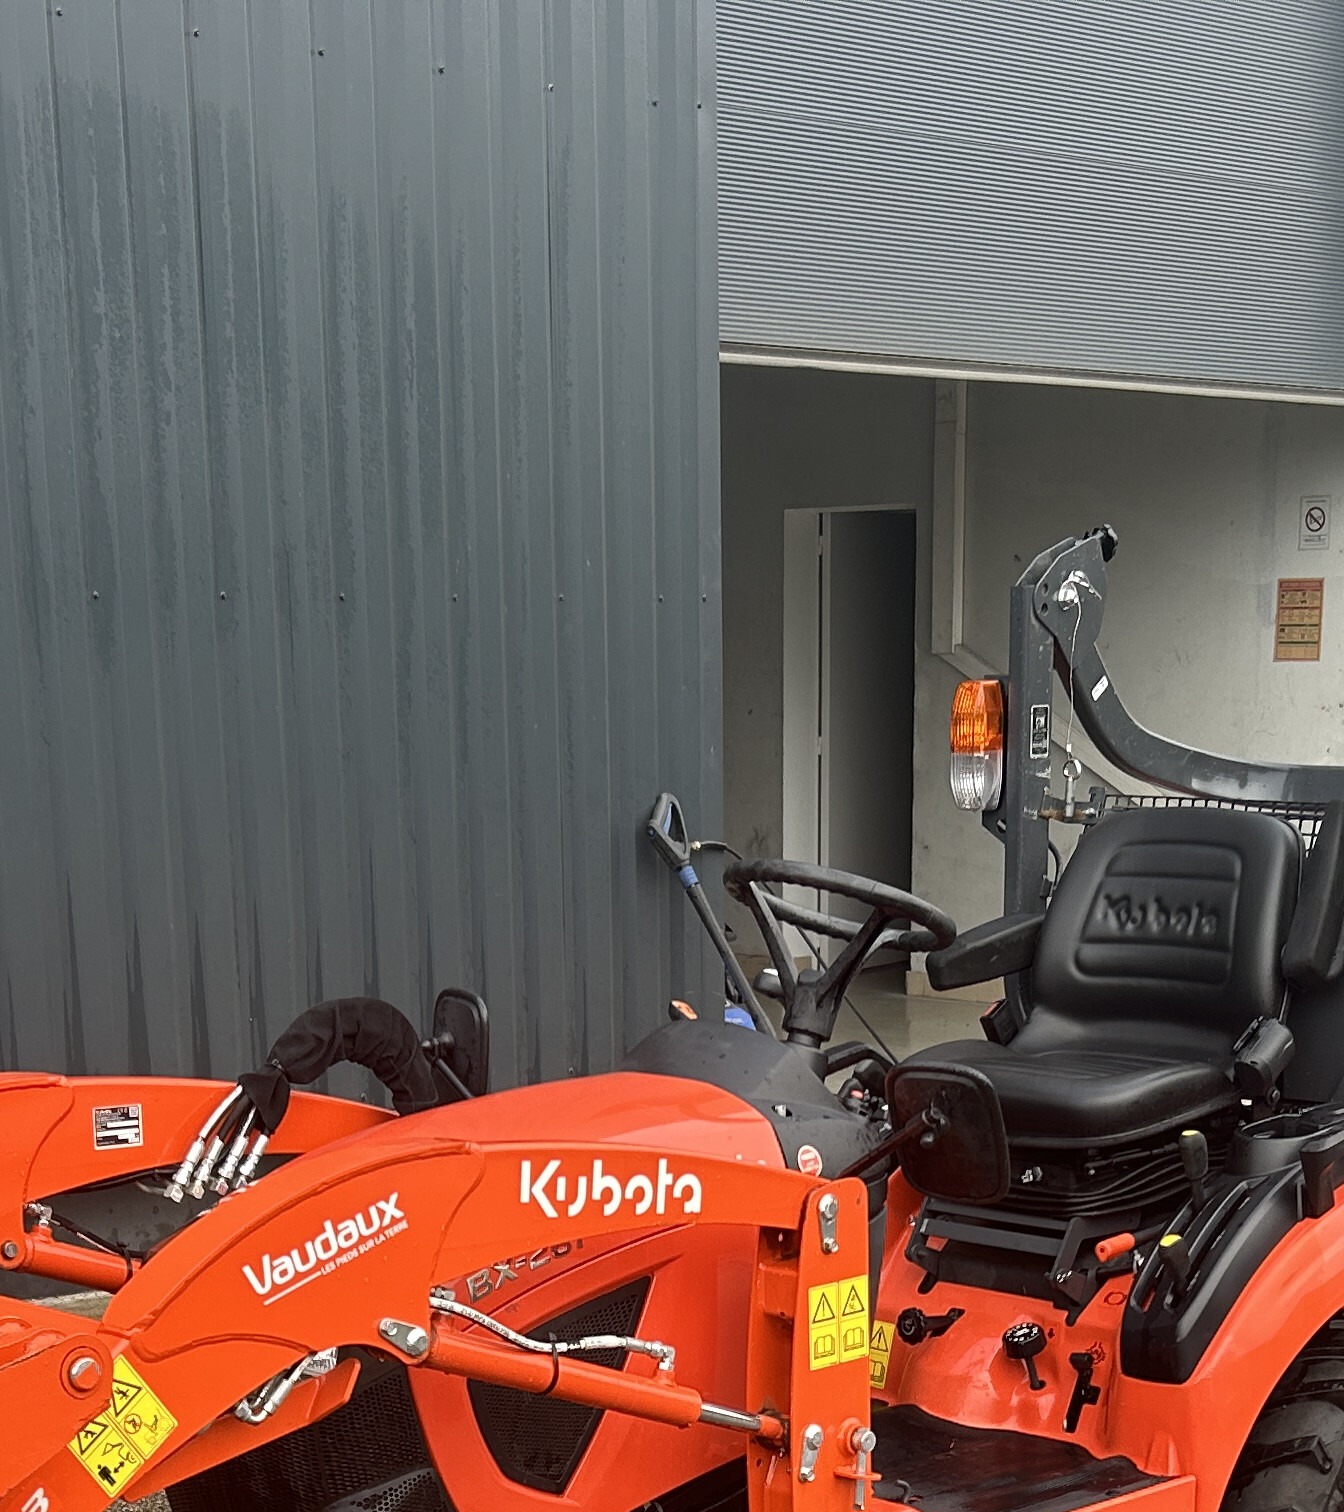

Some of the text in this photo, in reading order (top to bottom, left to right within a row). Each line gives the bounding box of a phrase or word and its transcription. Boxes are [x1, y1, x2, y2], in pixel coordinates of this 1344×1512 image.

[520, 1158, 702, 1218] Kubota
[242, 1191, 405, 1295] Vaudaux
[320, 1219, 408, 1275] LES PIEDS SUR LA TERRE
